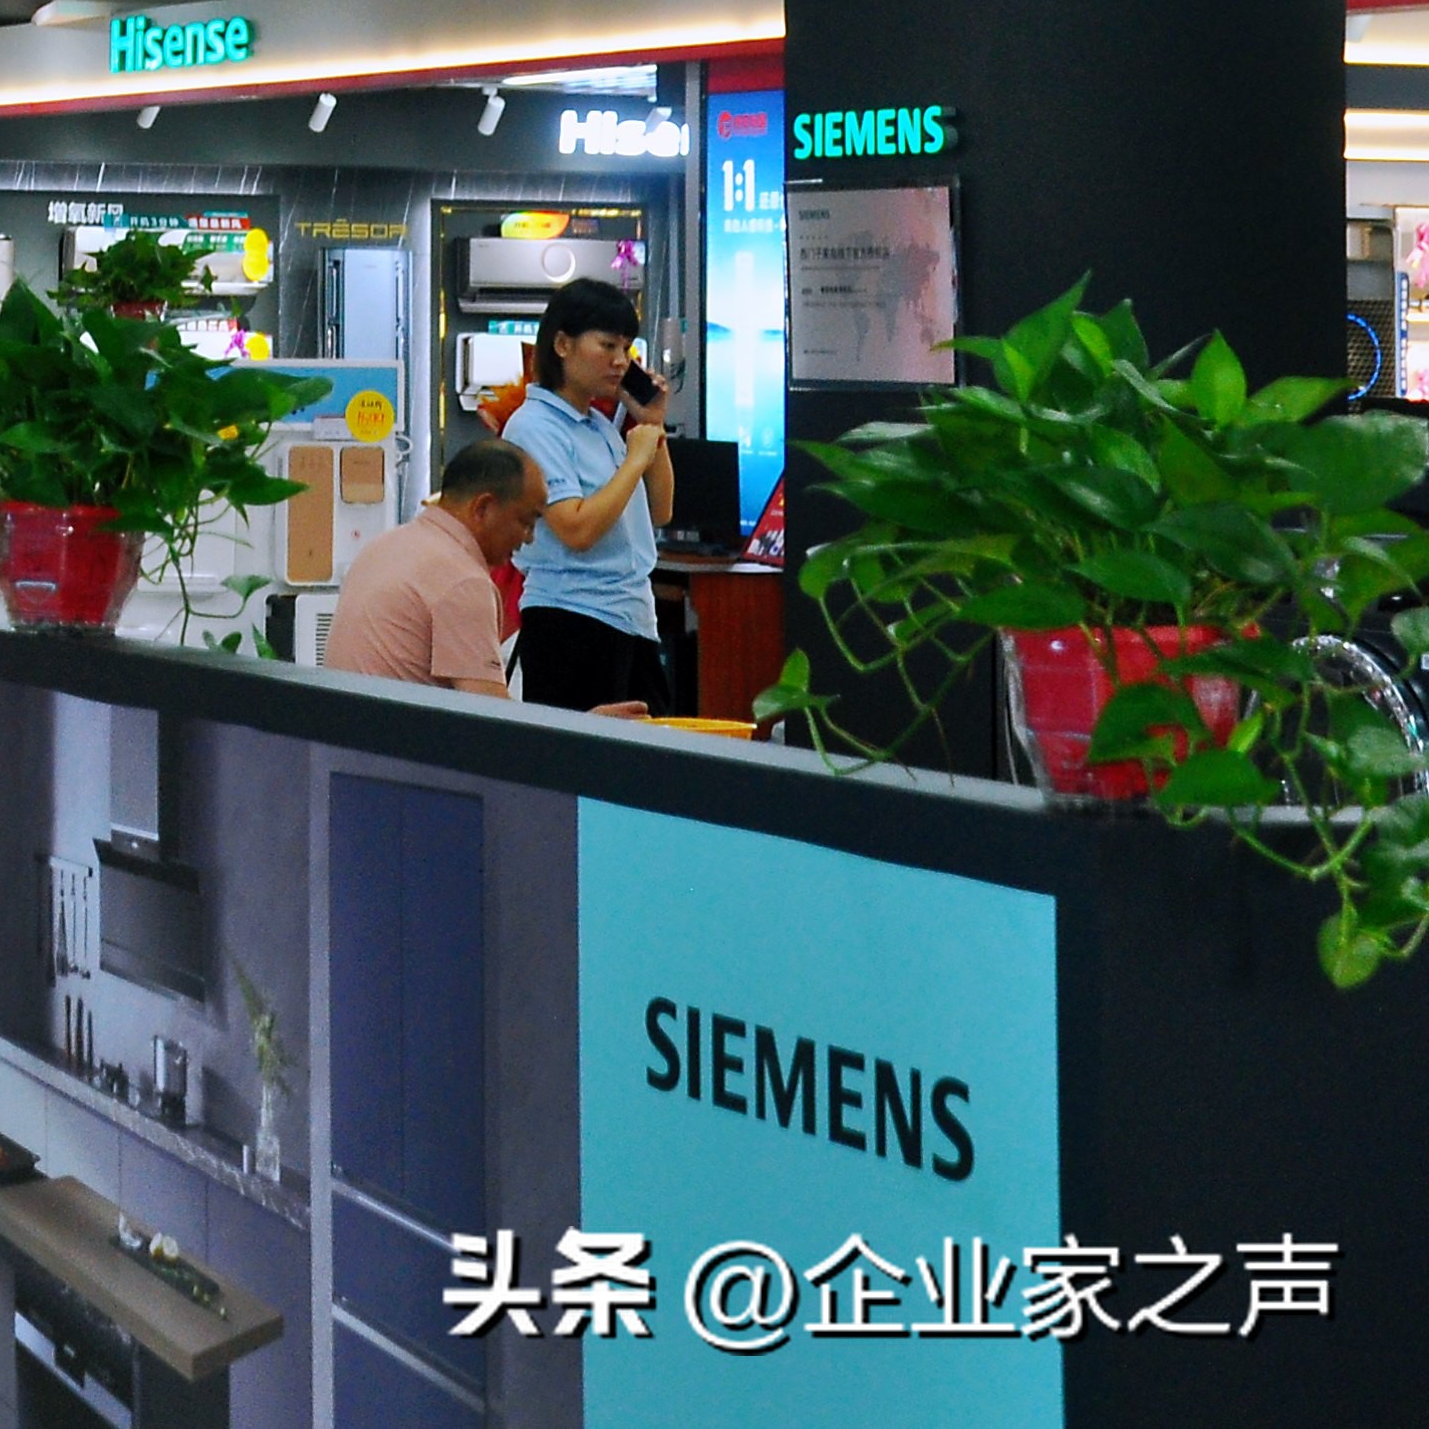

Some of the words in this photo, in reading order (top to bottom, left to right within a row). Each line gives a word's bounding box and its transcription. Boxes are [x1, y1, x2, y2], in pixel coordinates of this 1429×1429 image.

[111, 15, 253, 73] Hisense
[792, 104, 946, 160] SIEMENS
[644, 996, 976, 1182] SIEMENS
